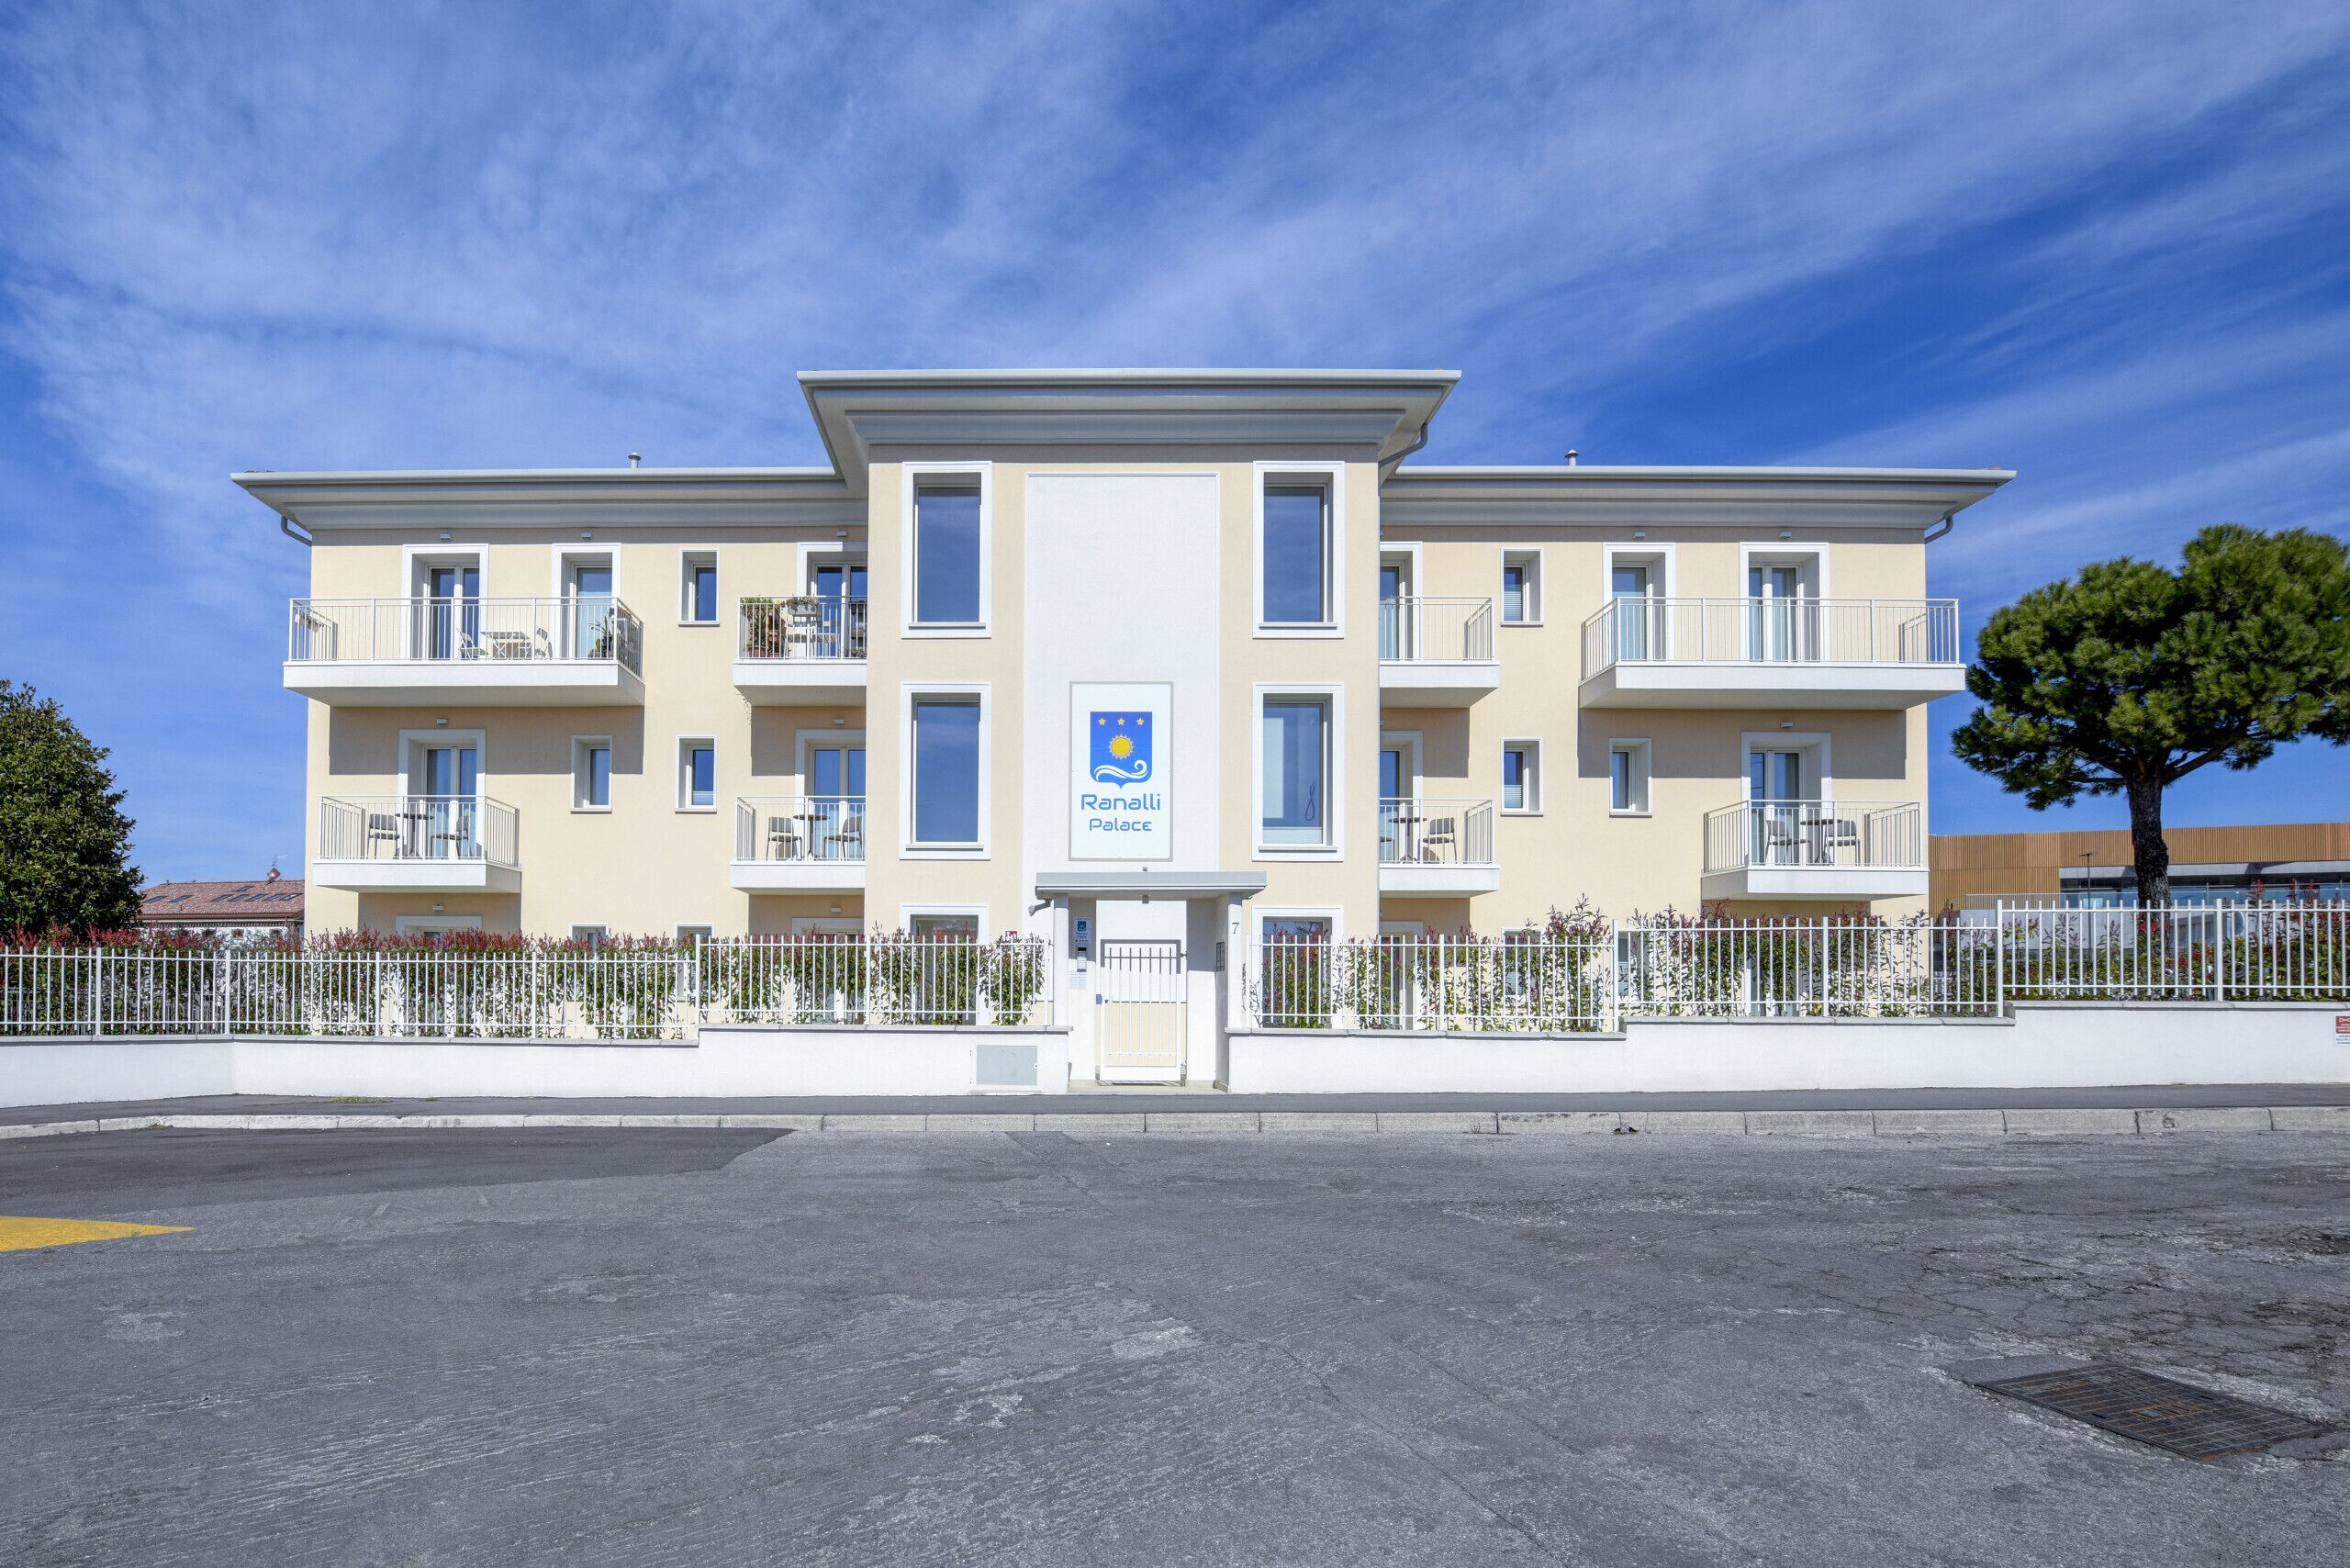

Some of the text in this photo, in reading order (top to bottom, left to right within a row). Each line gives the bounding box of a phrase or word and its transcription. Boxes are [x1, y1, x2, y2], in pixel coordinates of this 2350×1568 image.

[1081, 793, 1160, 811] Ranalli
[1090, 818, 1152, 832] Palace
[1232, 922, 1240, 935] 7
